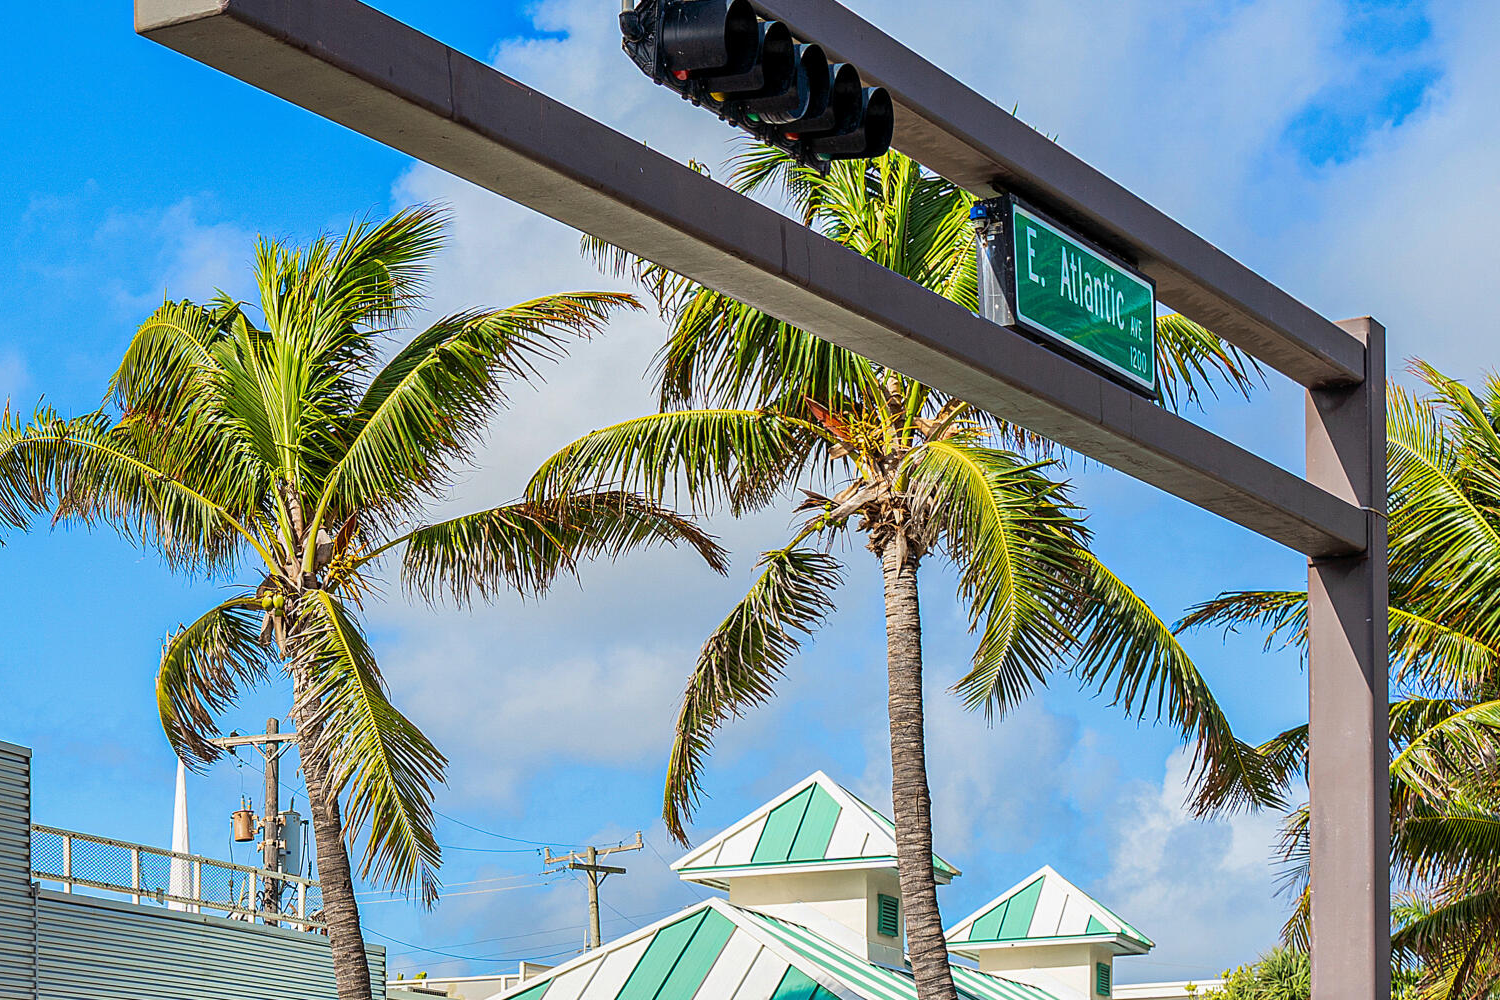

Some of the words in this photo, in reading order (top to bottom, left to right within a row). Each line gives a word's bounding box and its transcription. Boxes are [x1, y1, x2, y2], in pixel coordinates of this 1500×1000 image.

[1026, 226, 1046, 287] E.
[1060, 246, 1125, 330] Atlantic
[1130, 316, 1143, 341] AVE
[1130, 346, 1147, 374] 1200
